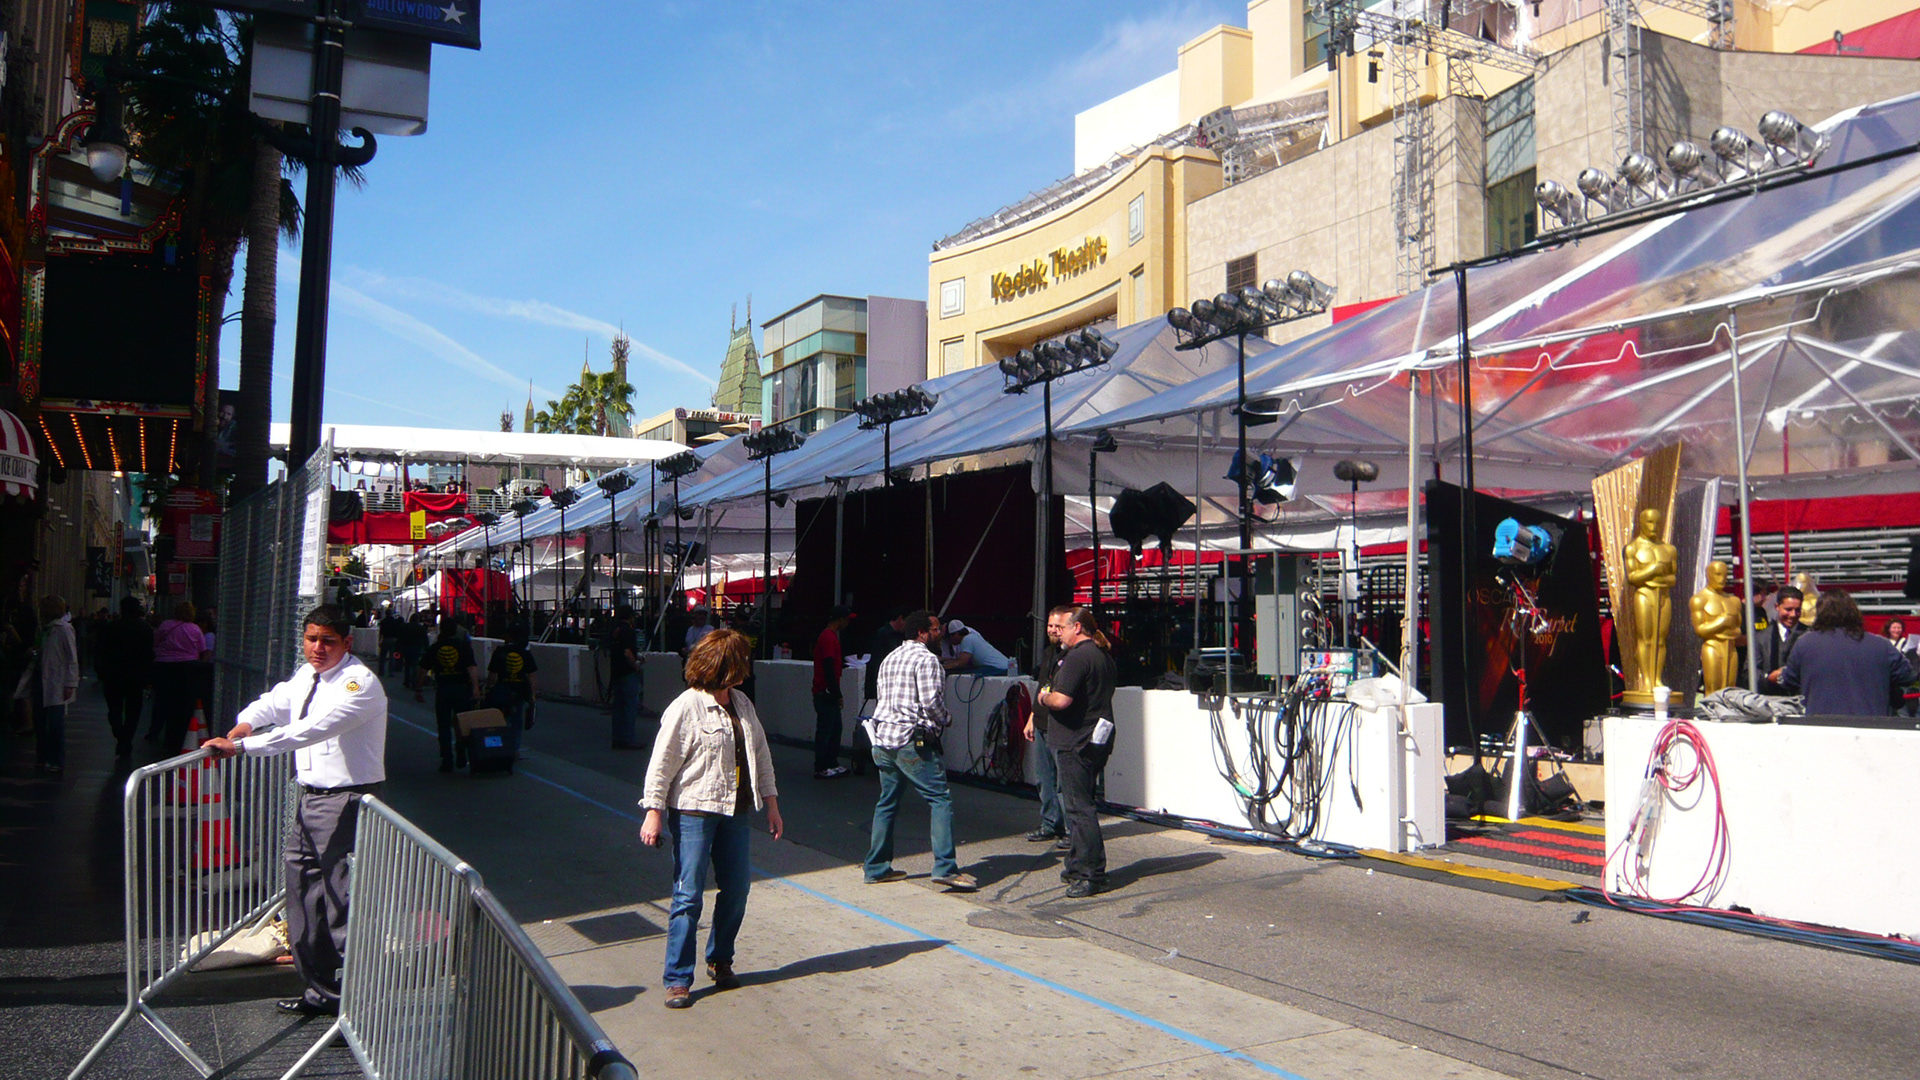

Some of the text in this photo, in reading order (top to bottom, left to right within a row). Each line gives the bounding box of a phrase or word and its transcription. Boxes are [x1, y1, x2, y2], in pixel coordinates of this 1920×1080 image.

[366, 0, 441, 21] HOLLYWOOD
[990, 234, 1108, 299] Kodak Theatre
[1, 456, 11, 475] ICE
[1533, 633, 1554, 645] 2010
